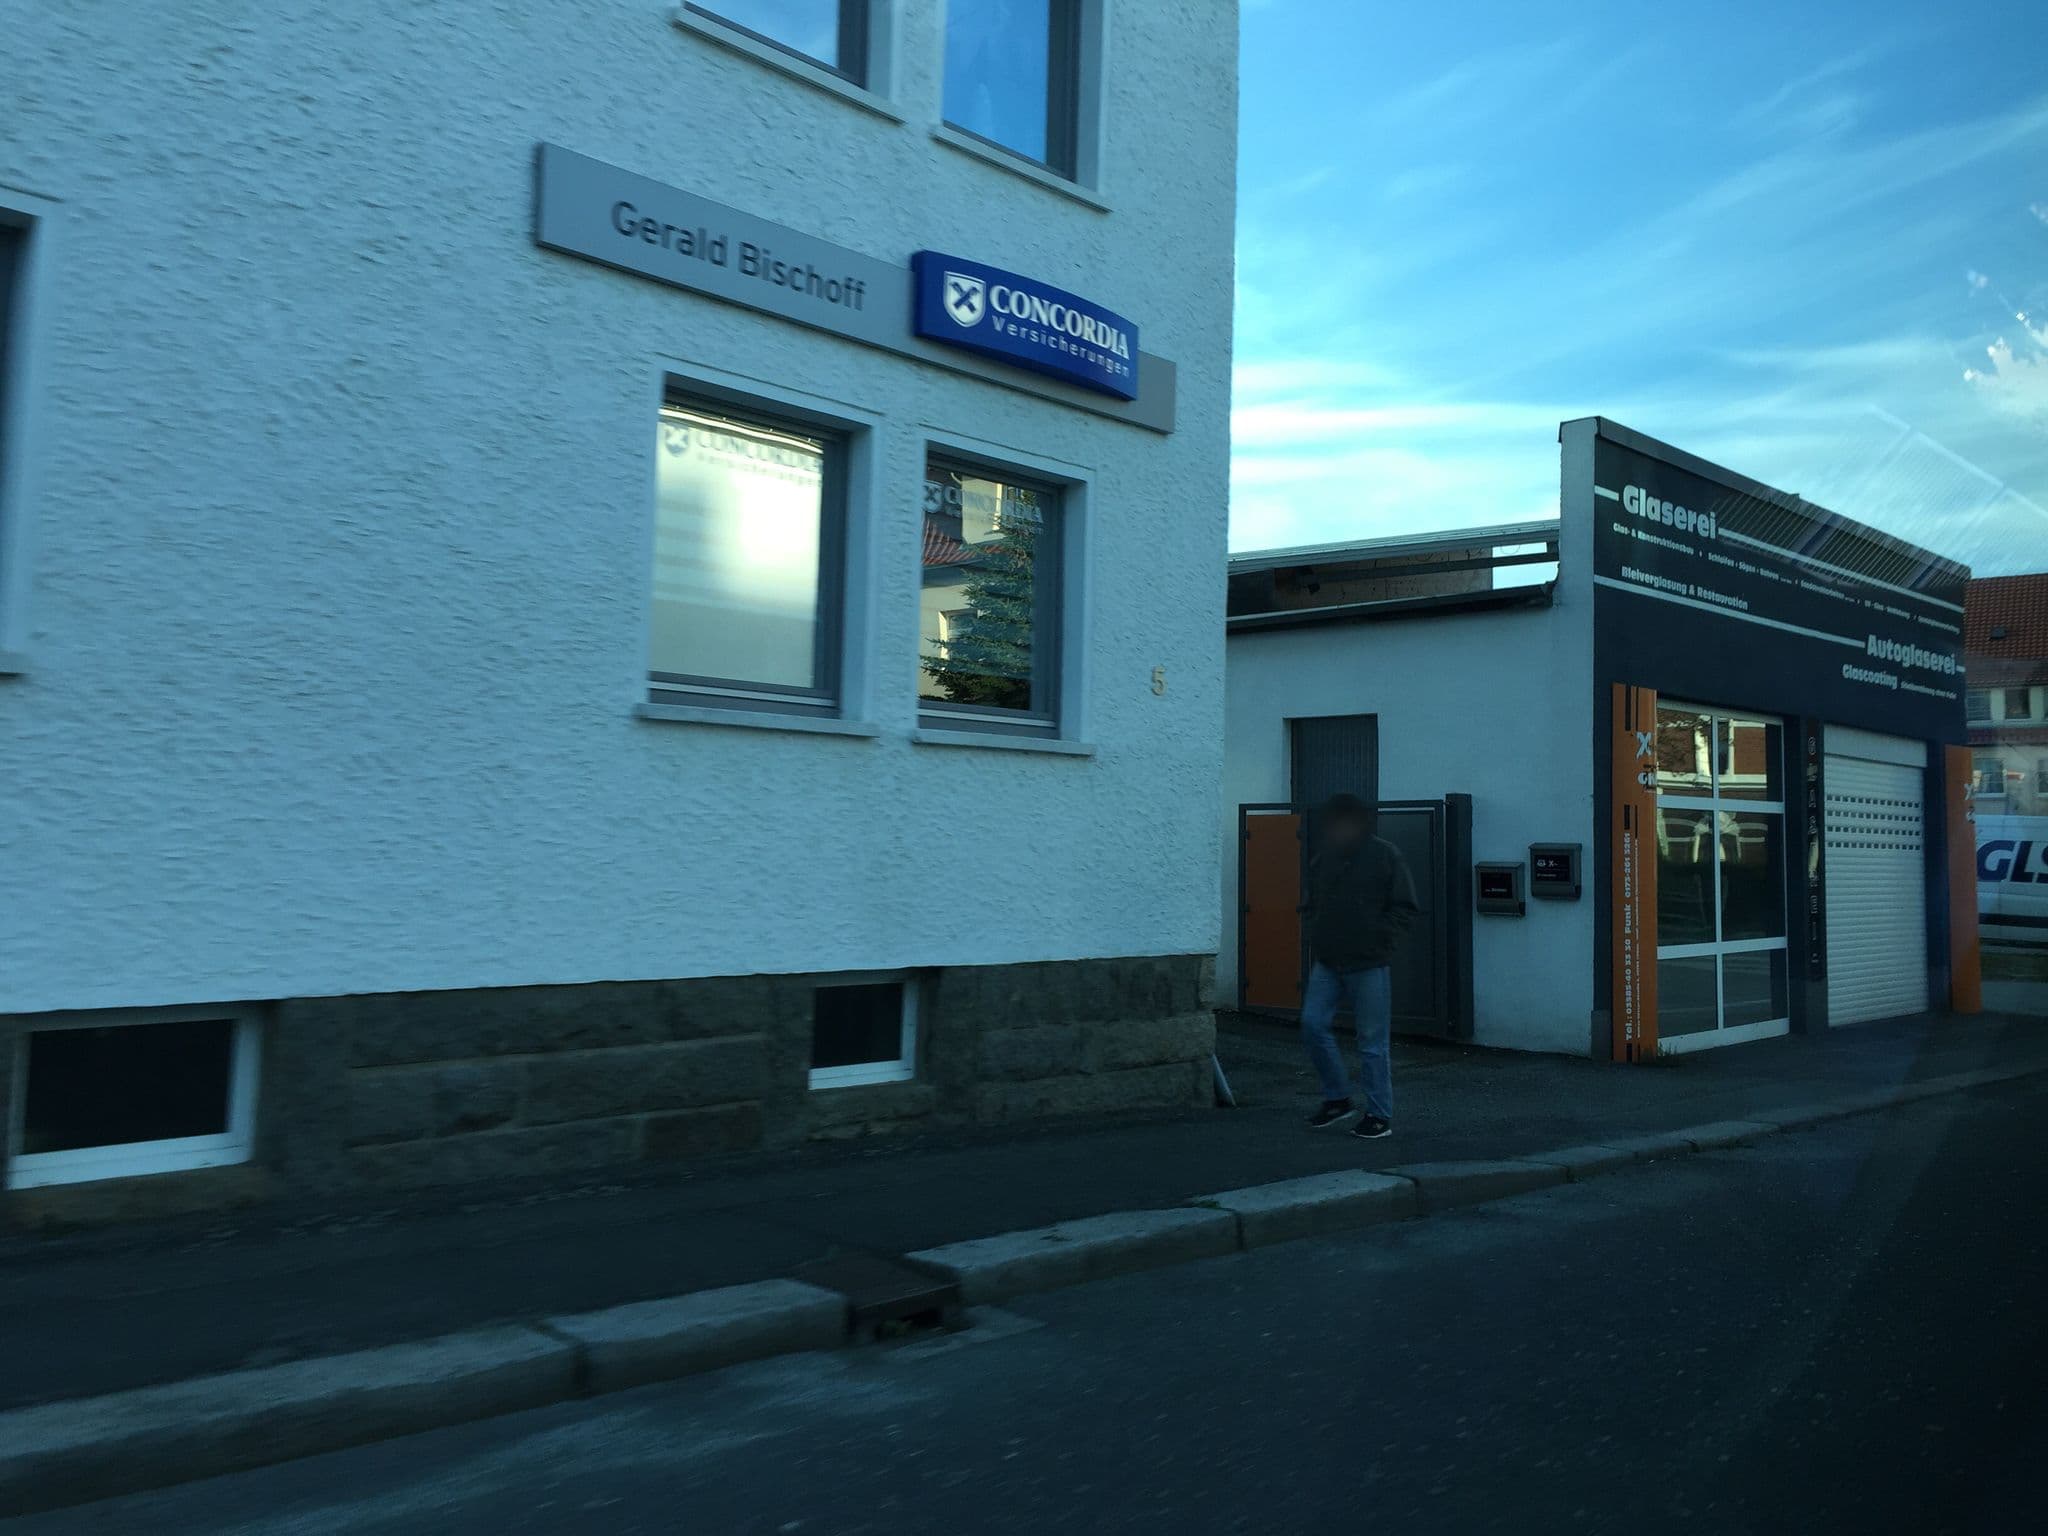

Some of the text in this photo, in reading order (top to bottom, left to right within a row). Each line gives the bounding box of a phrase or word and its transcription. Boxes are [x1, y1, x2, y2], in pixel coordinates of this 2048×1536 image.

[611, 200, 867, 312] Gerald Bischoff
[990, 284, 1130, 361] CONCORDIA
[992, 314, 1130, 378] Versicherungen
[1623, 484, 1717, 540] Glaserei
[1621, 566, 1749, 611] Bleiverglasung & Restauration
[1842, 664, 1898, 690] Glascoating
[1867, 634, 1956, 676] Autoglaserei
[1151, 664, 1168, 697] 5
